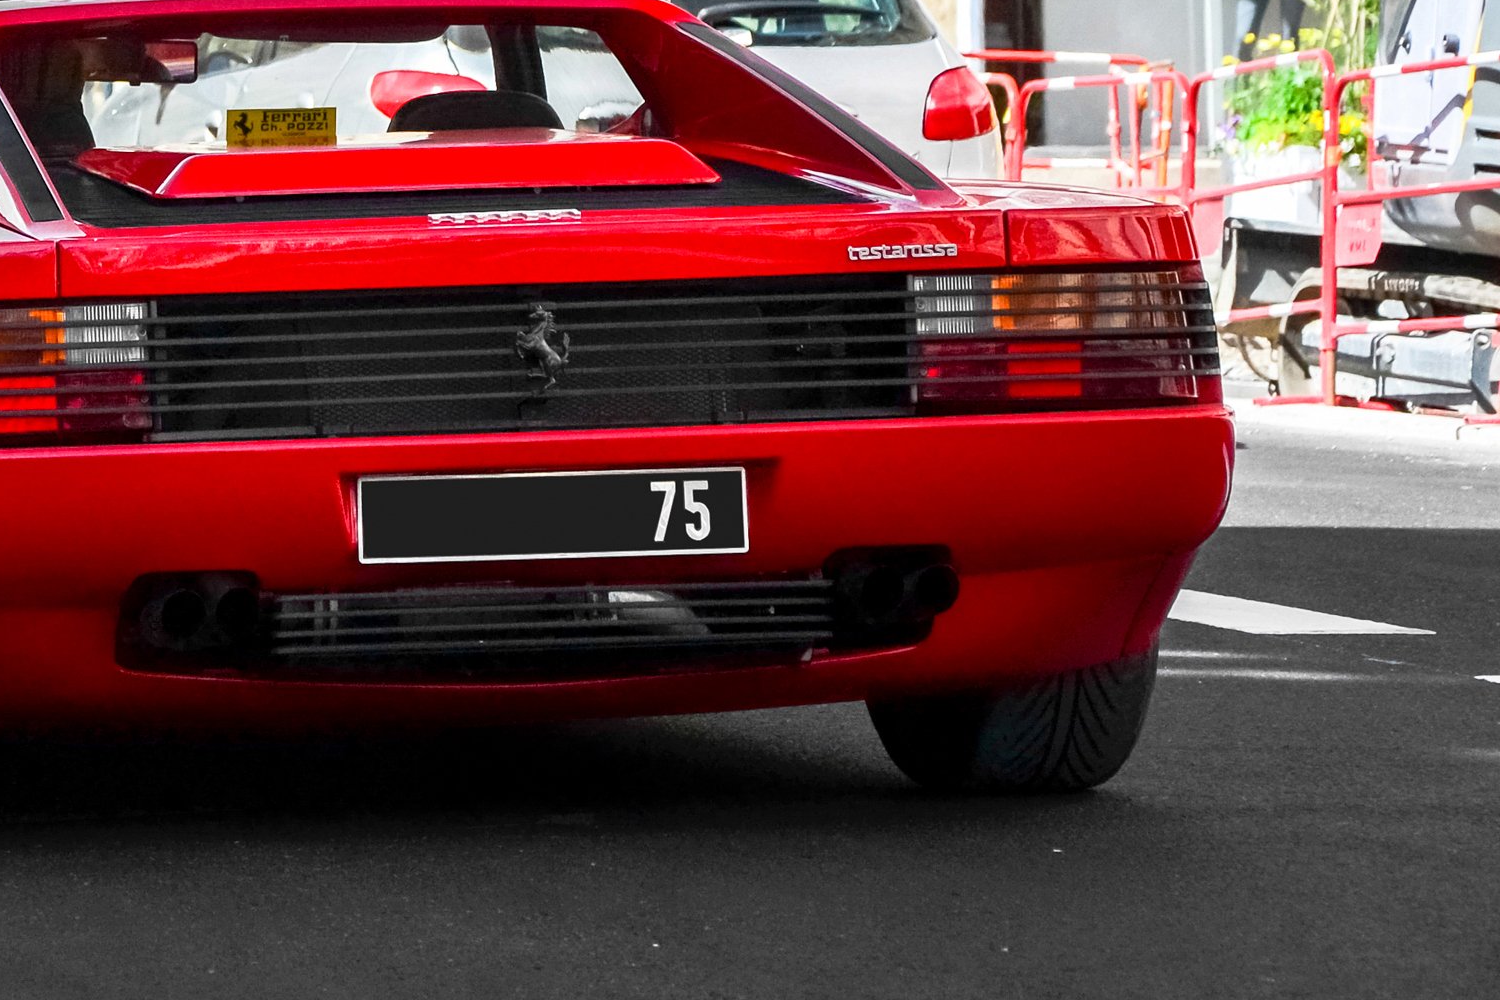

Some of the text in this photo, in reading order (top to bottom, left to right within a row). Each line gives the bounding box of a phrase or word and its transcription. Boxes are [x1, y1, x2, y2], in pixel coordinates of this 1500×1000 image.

[261, 110, 328, 123] Ferrari
[287, 122, 328, 131] POZZI
[847, 243, 958, 260] testarossa
[650, 480, 711, 542] 75
